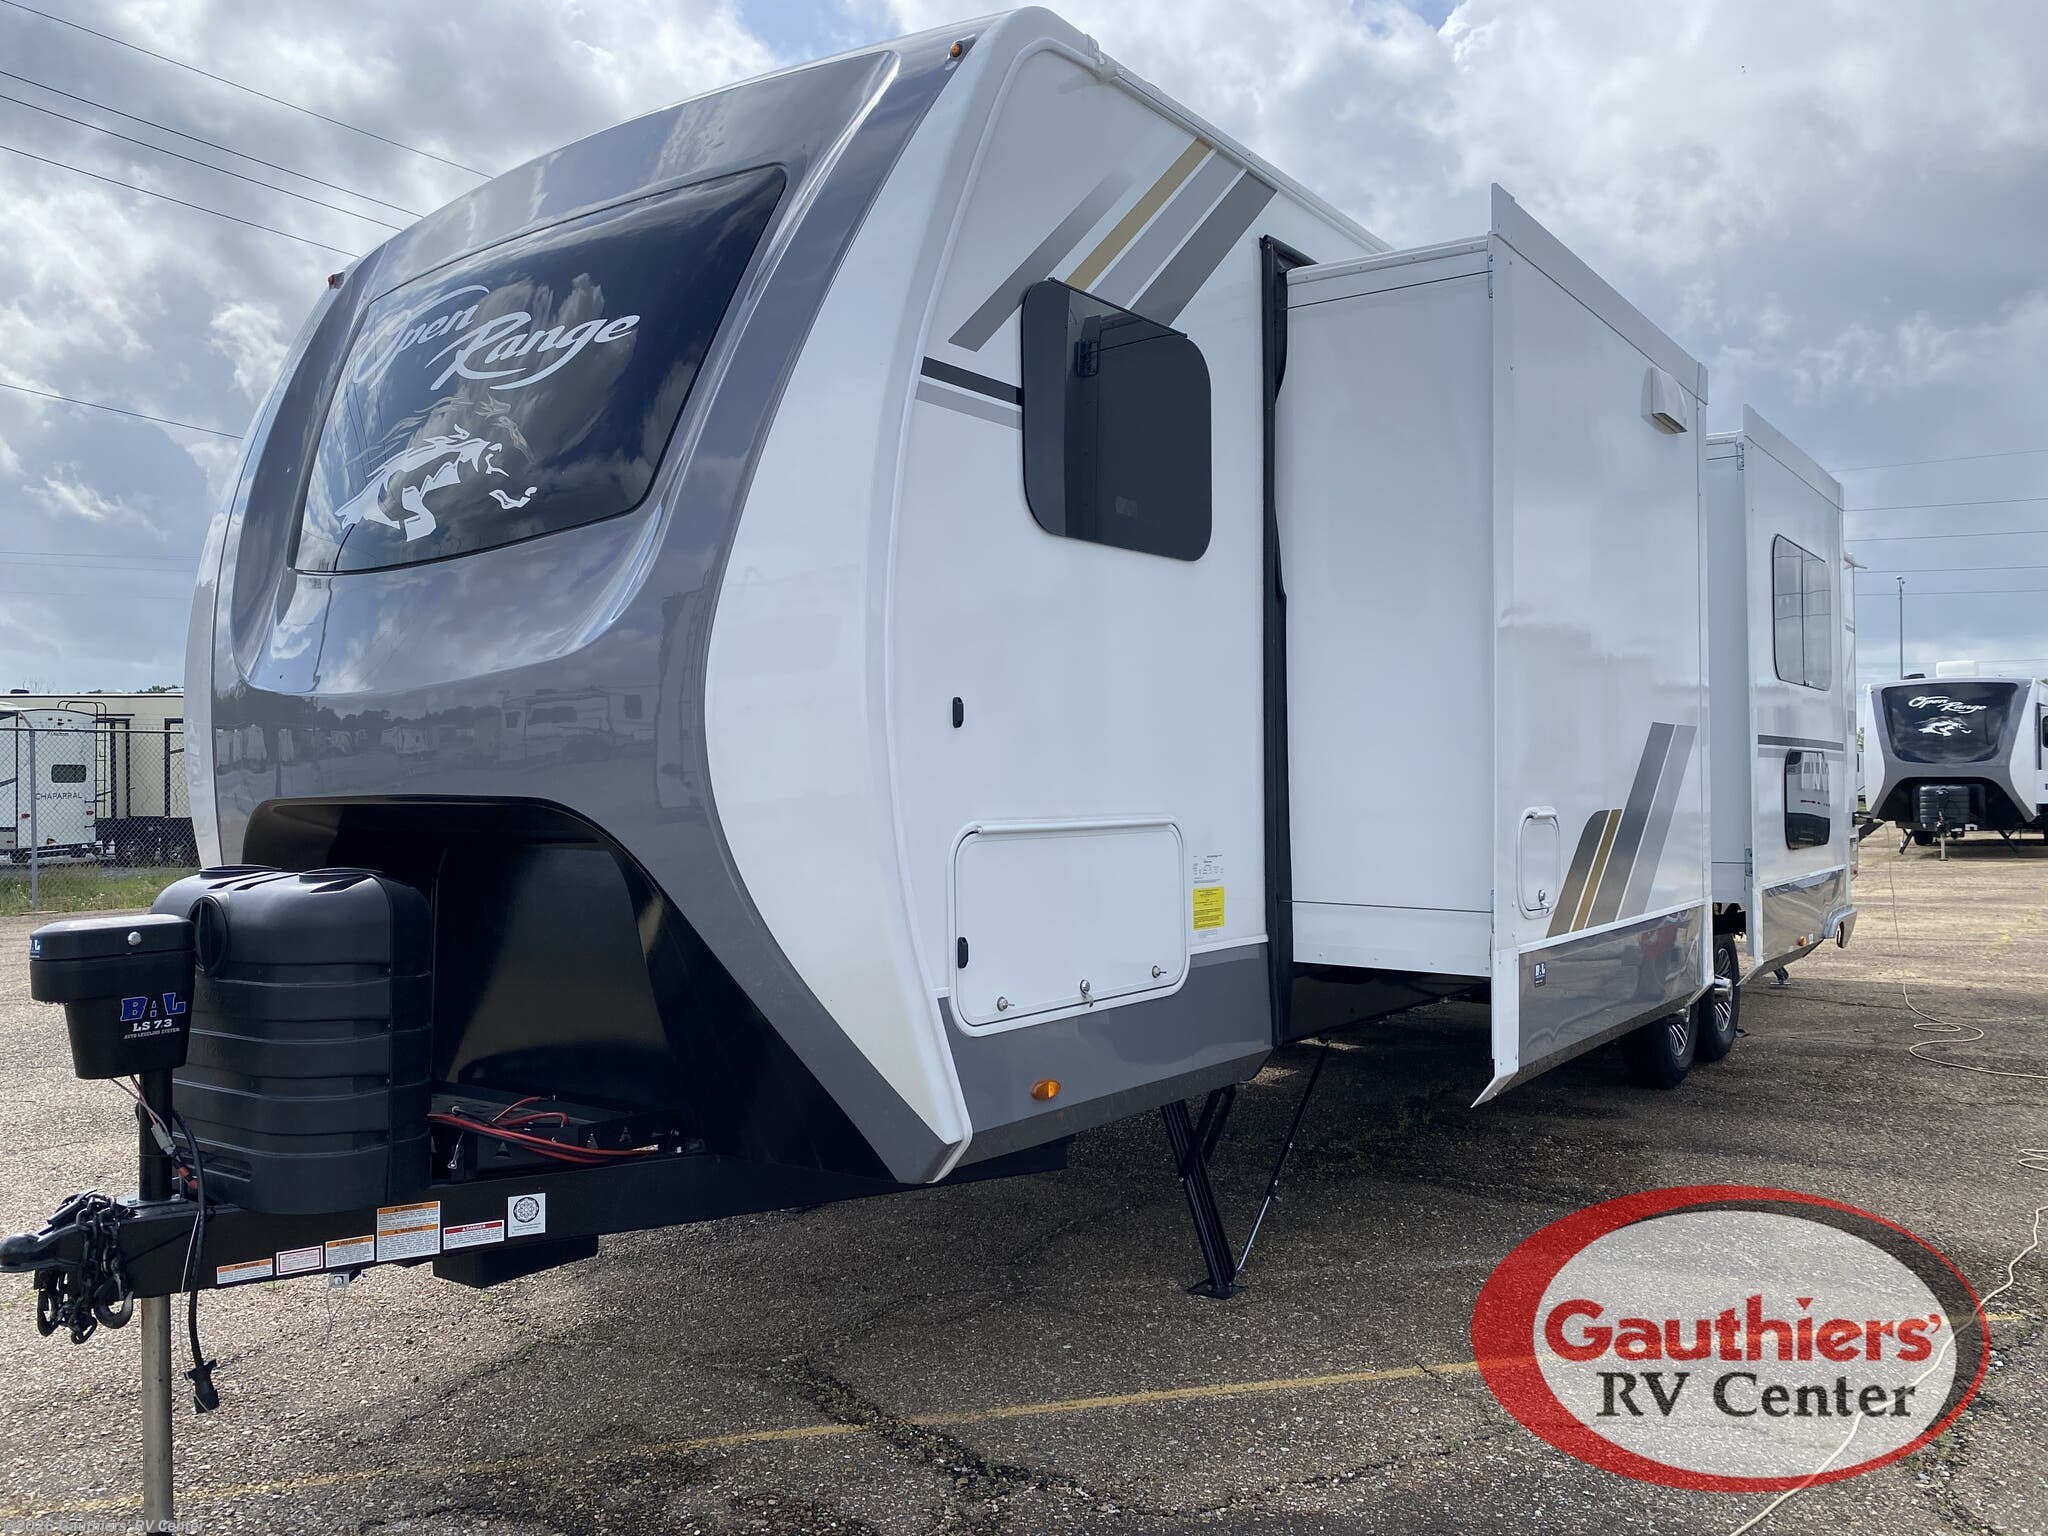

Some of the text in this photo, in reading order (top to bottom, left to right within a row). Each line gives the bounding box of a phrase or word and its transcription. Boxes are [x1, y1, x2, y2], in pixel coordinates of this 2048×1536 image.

[352, 285, 641, 391] Open Range
[1908, 696, 1988, 714] Open Range
[35, 792, 83, 800] CHAPARRAL
[132, 1021, 151, 1033] LS
